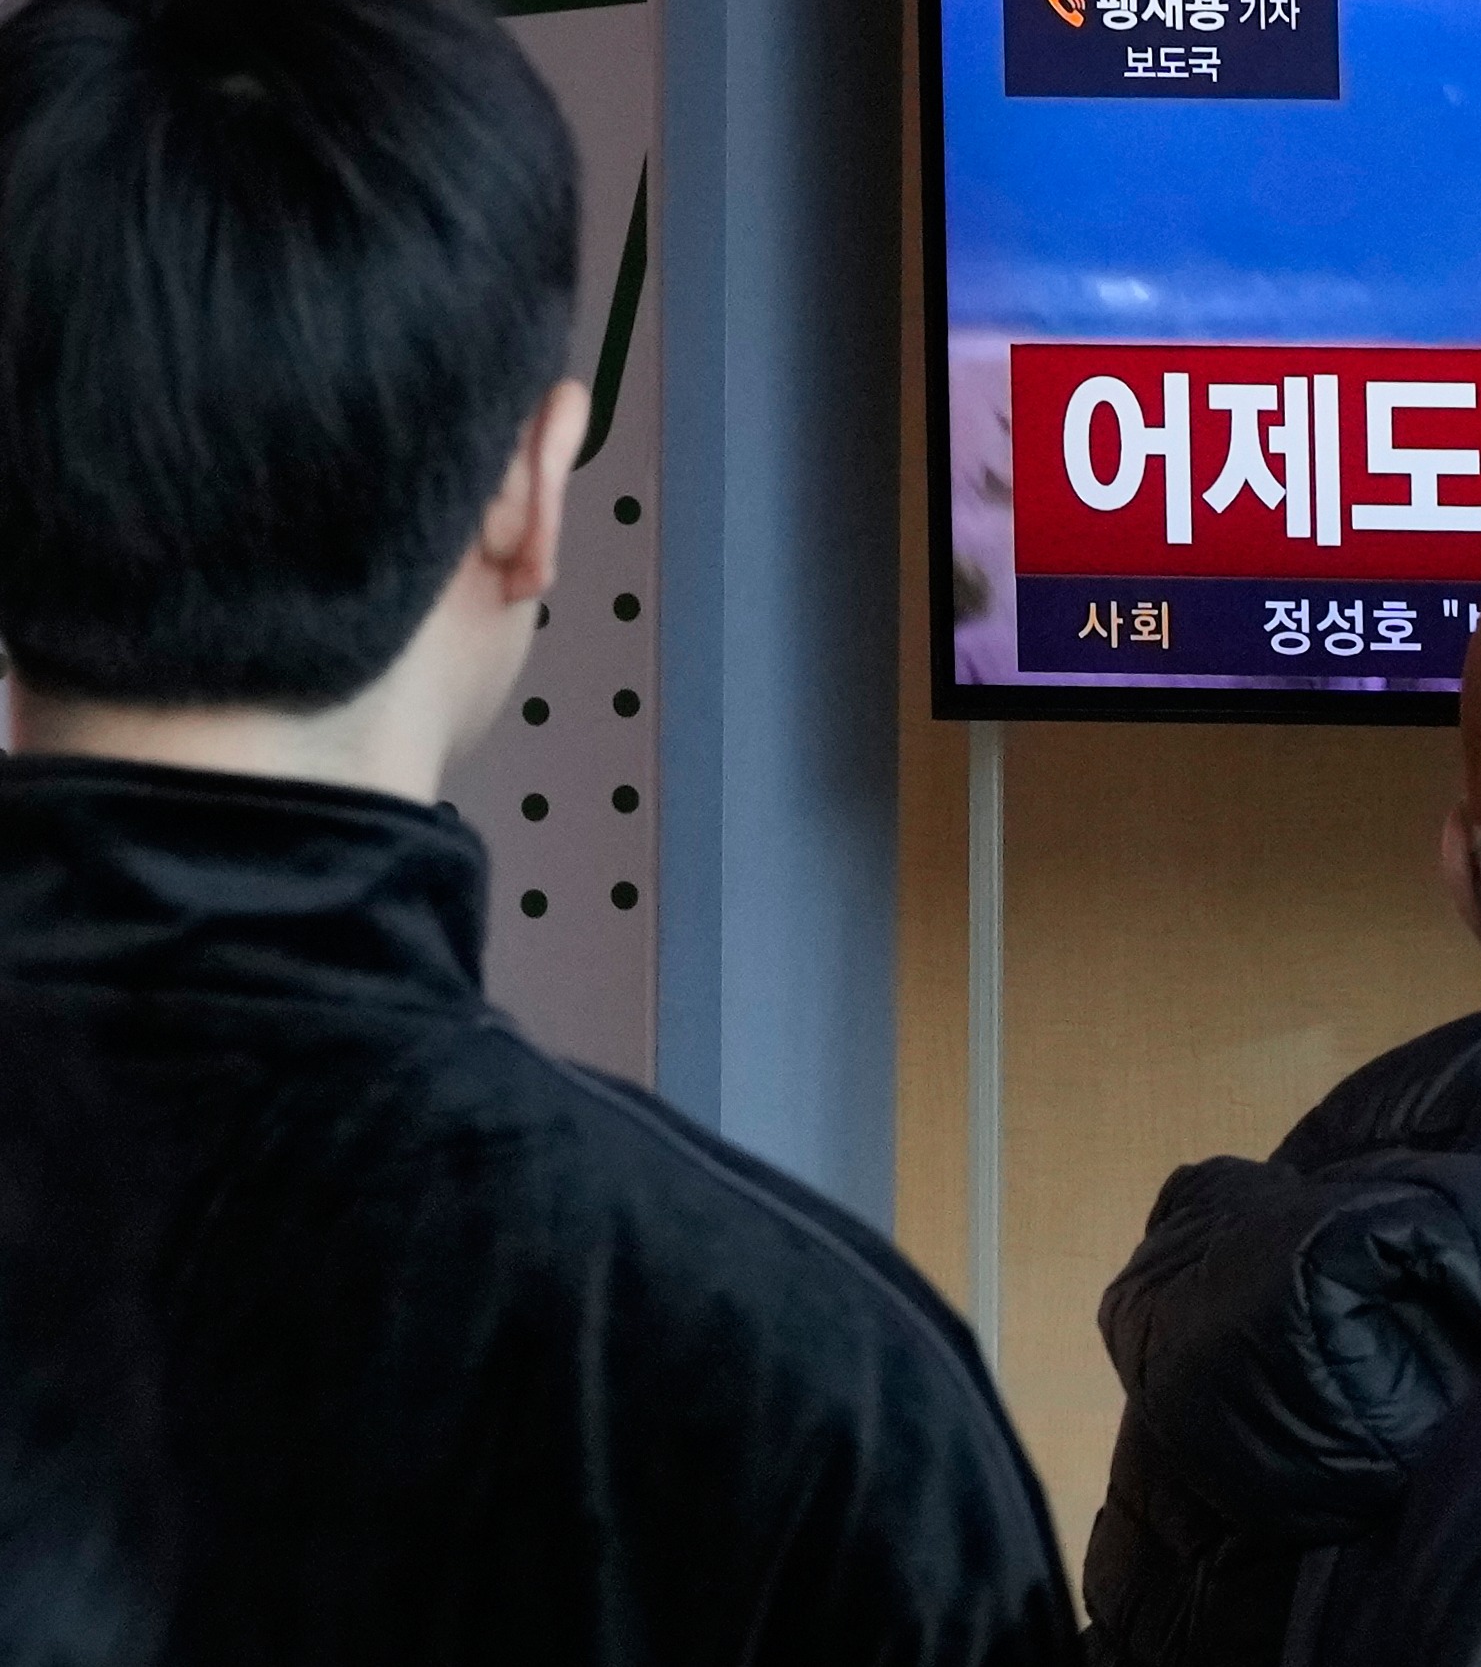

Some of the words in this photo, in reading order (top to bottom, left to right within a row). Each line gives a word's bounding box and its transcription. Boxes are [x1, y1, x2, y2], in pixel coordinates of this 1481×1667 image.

[1123, 46, 1222, 83] 보도국
[1078, 600, 1170, 650] 사회
[1263, 599, 1422, 657] 정성호
